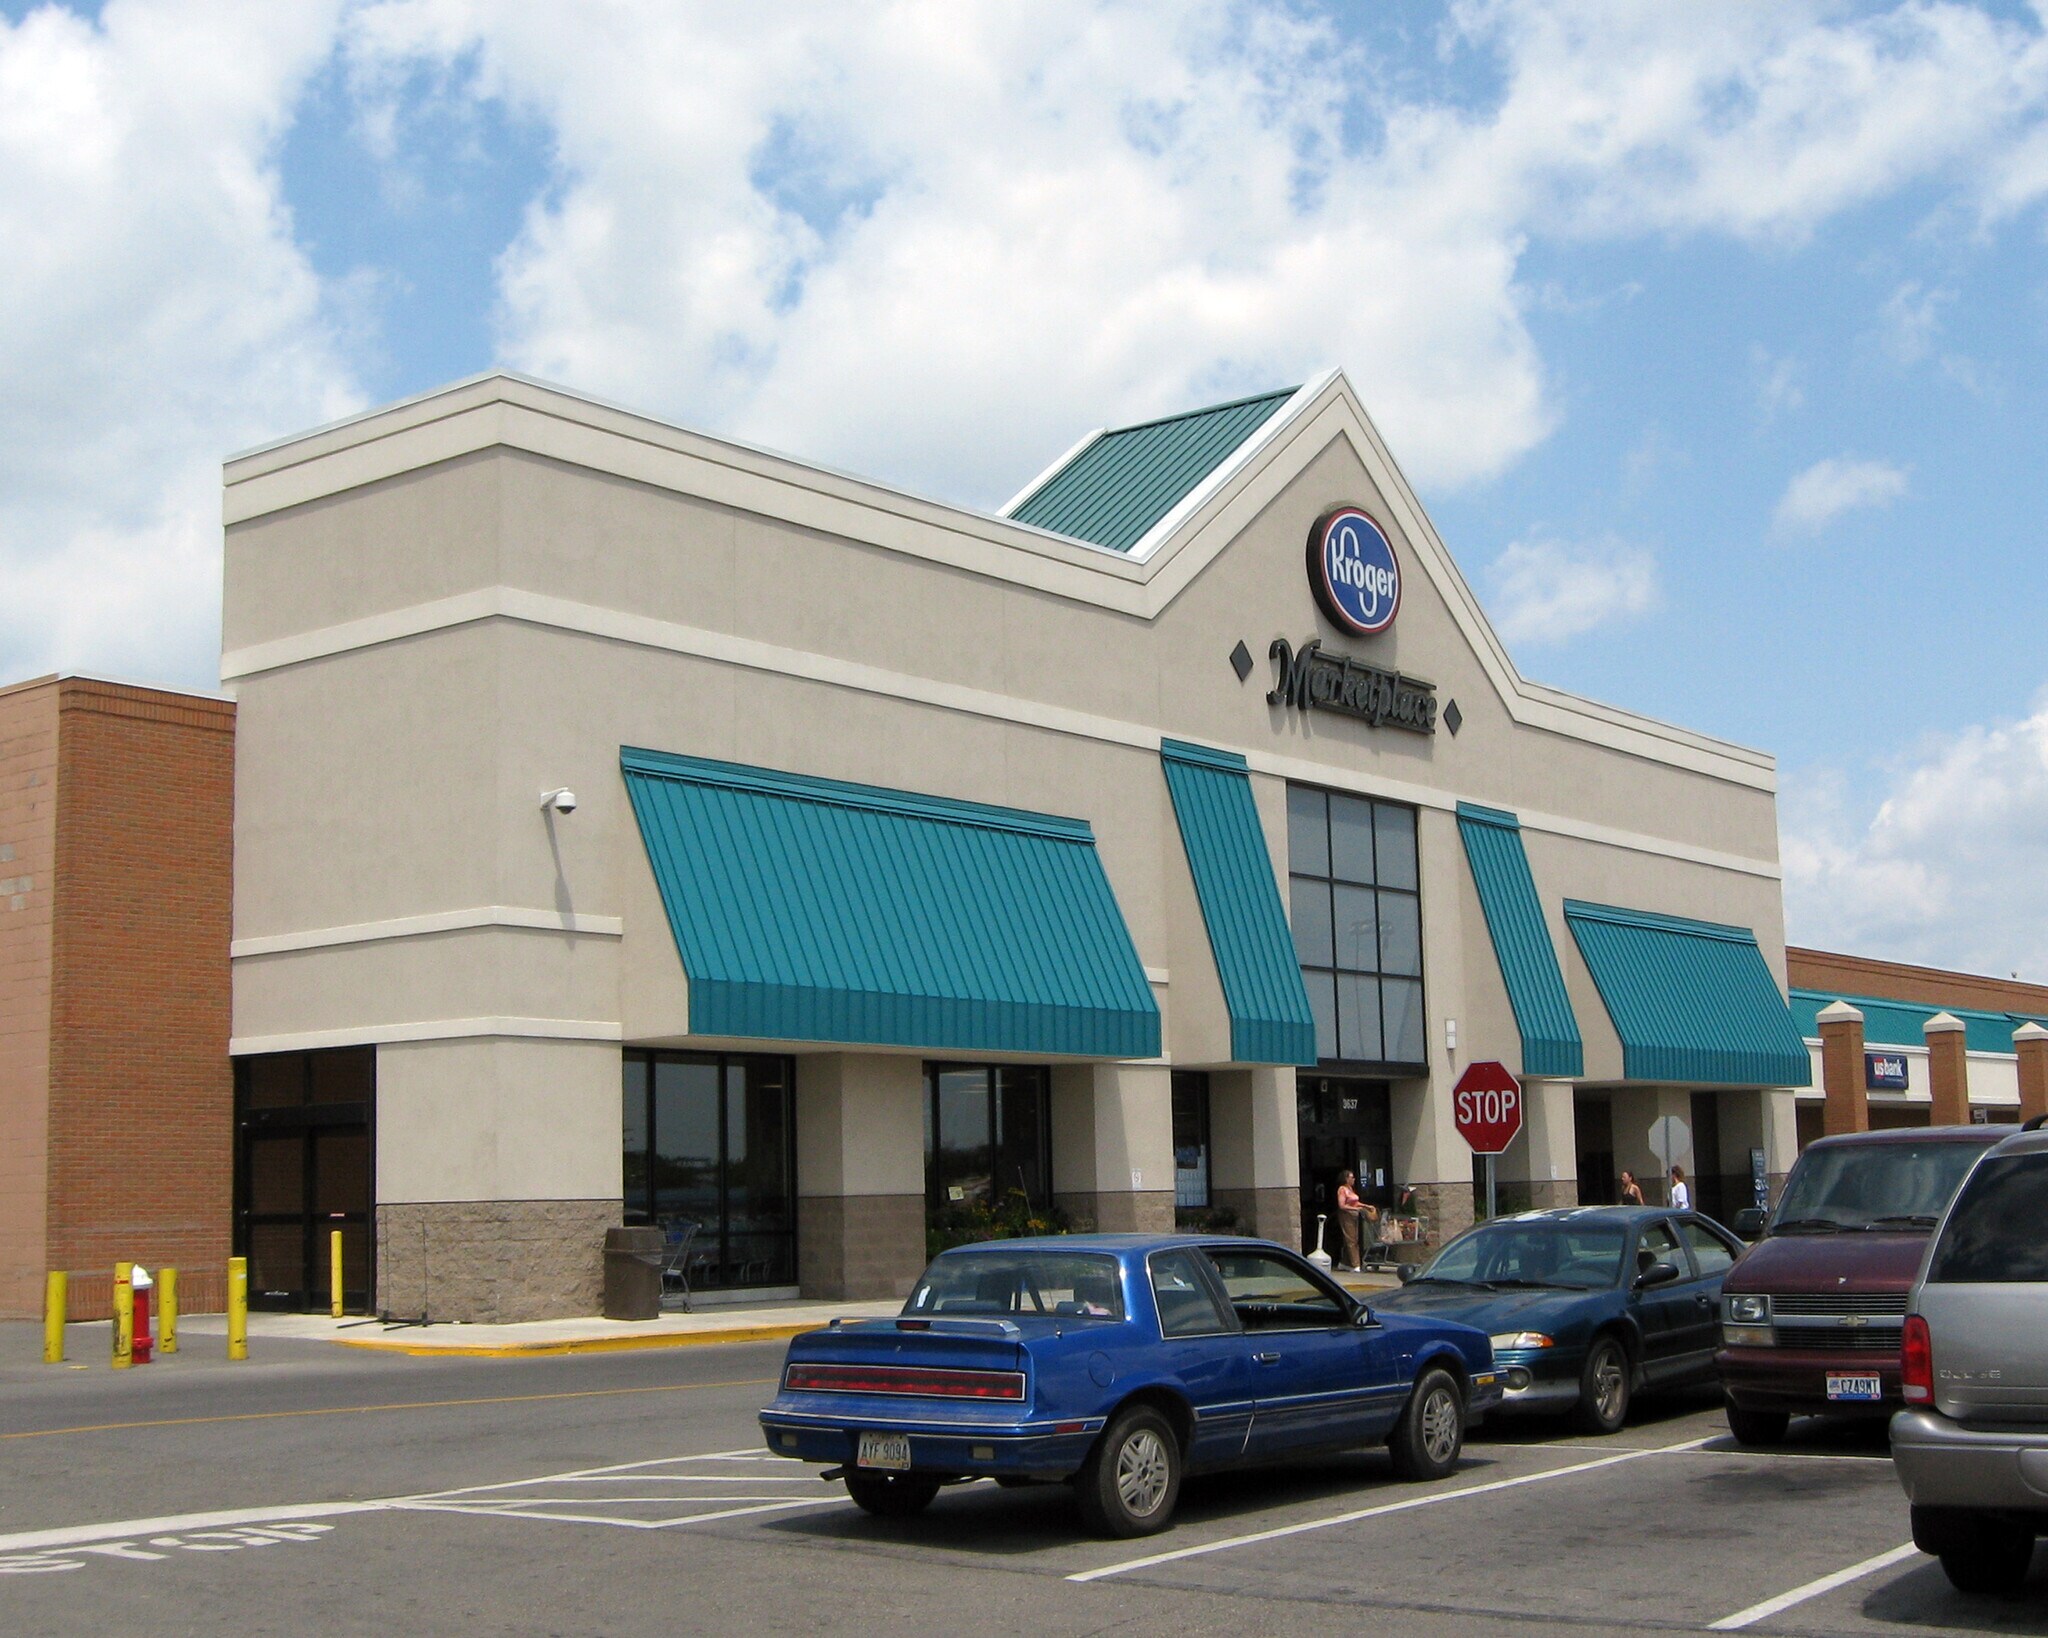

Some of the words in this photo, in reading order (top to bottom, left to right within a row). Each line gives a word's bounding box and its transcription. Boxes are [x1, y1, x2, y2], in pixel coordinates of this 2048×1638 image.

[1331, 526, 1395, 617] Kroger
[1266, 638, 1437, 731] Marketplace
[1458, 1090, 1516, 1124] STOP
